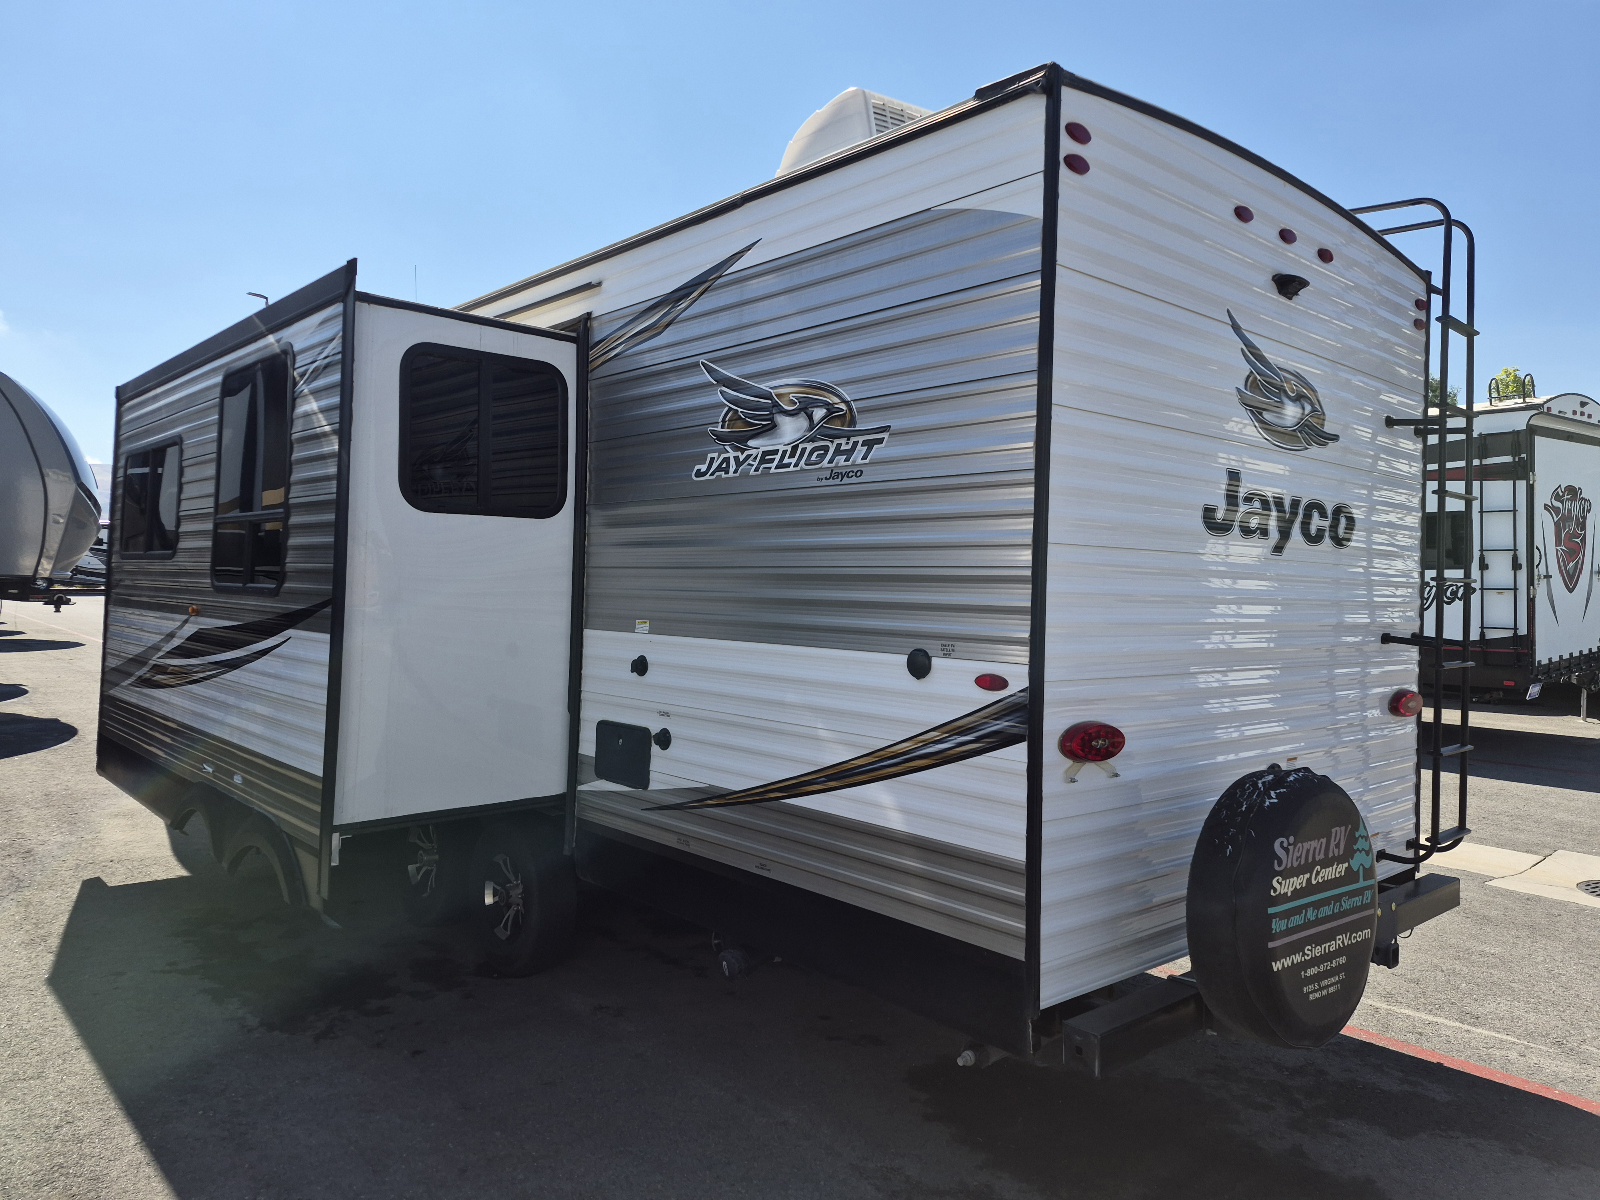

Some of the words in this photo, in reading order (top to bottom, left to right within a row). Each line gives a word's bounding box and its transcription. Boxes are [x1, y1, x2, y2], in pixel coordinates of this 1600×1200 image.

[825, 468, 863, 482] Jayco
[1202, 468, 1356, 556] Jayco
[1274, 836, 1327, 871] Sierra
[1329, 824, 1352, 858] RV
[1270, 873, 1311, 896] Super
[1311, 862, 1349, 885] Center
[1272, 917, 1288, 933] You
[1288, 910, 1305, 928] and
[1306, 906, 1318, 922] Me
[1318, 901, 1334, 918] and
[1334, 902, 1341, 913] a
[1341, 895, 1362, 911] Sierra
[1363, 889, 1374, 904] RV
[1272, 929, 1371, 972] www.SierraRV.com
[1301, 956, 1346, 979] 1-800-972-8760
[1320, 976, 1339, 987] VIRGINIA
